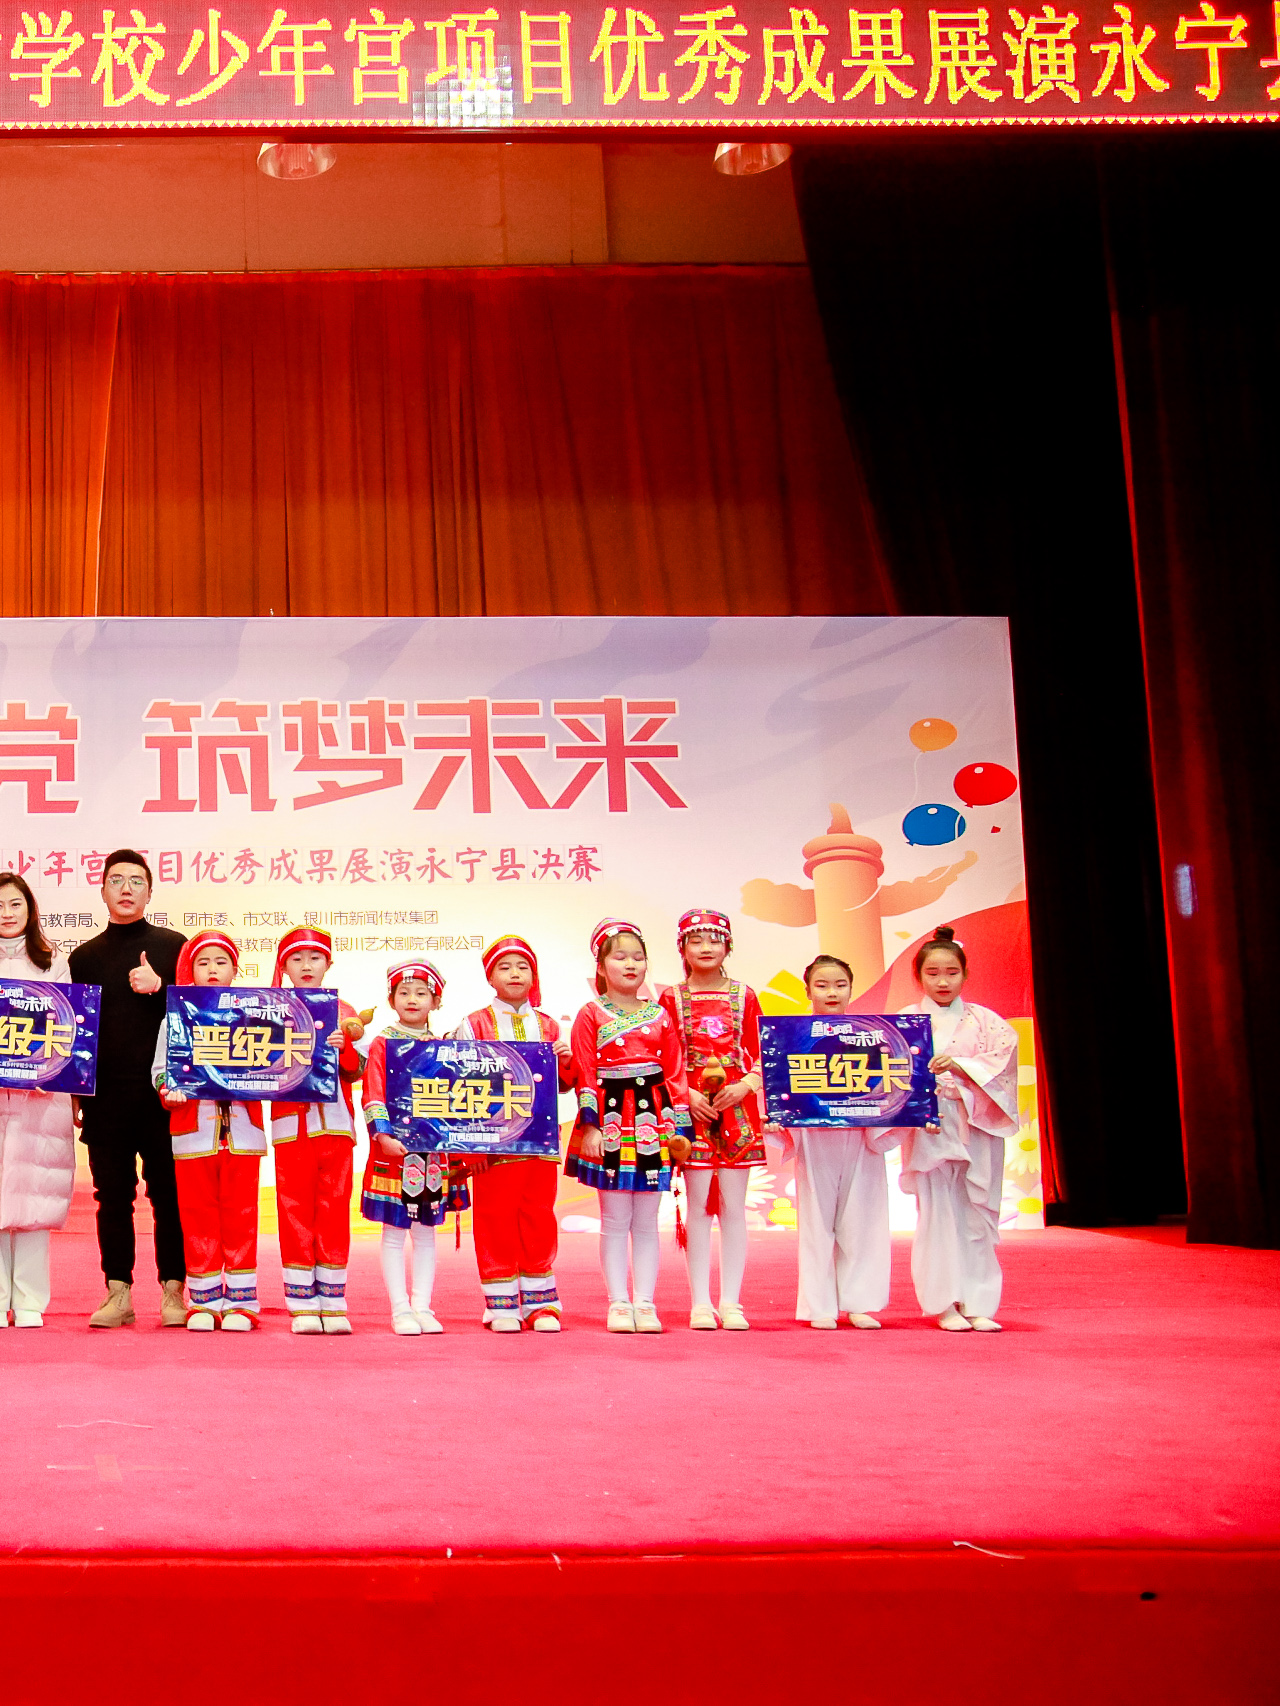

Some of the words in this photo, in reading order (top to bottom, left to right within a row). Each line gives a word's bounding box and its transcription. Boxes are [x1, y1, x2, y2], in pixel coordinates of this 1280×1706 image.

[141, 697, 688, 814] 筑梦未来
[334, 935, 485, 952] 银川艺术剧院有限公司
[192, 1025, 312, 1068] 晋级卡
[787, 1053, 913, 1094] 晋级卡
[411, 1077, 533, 1120] 晋级卡
